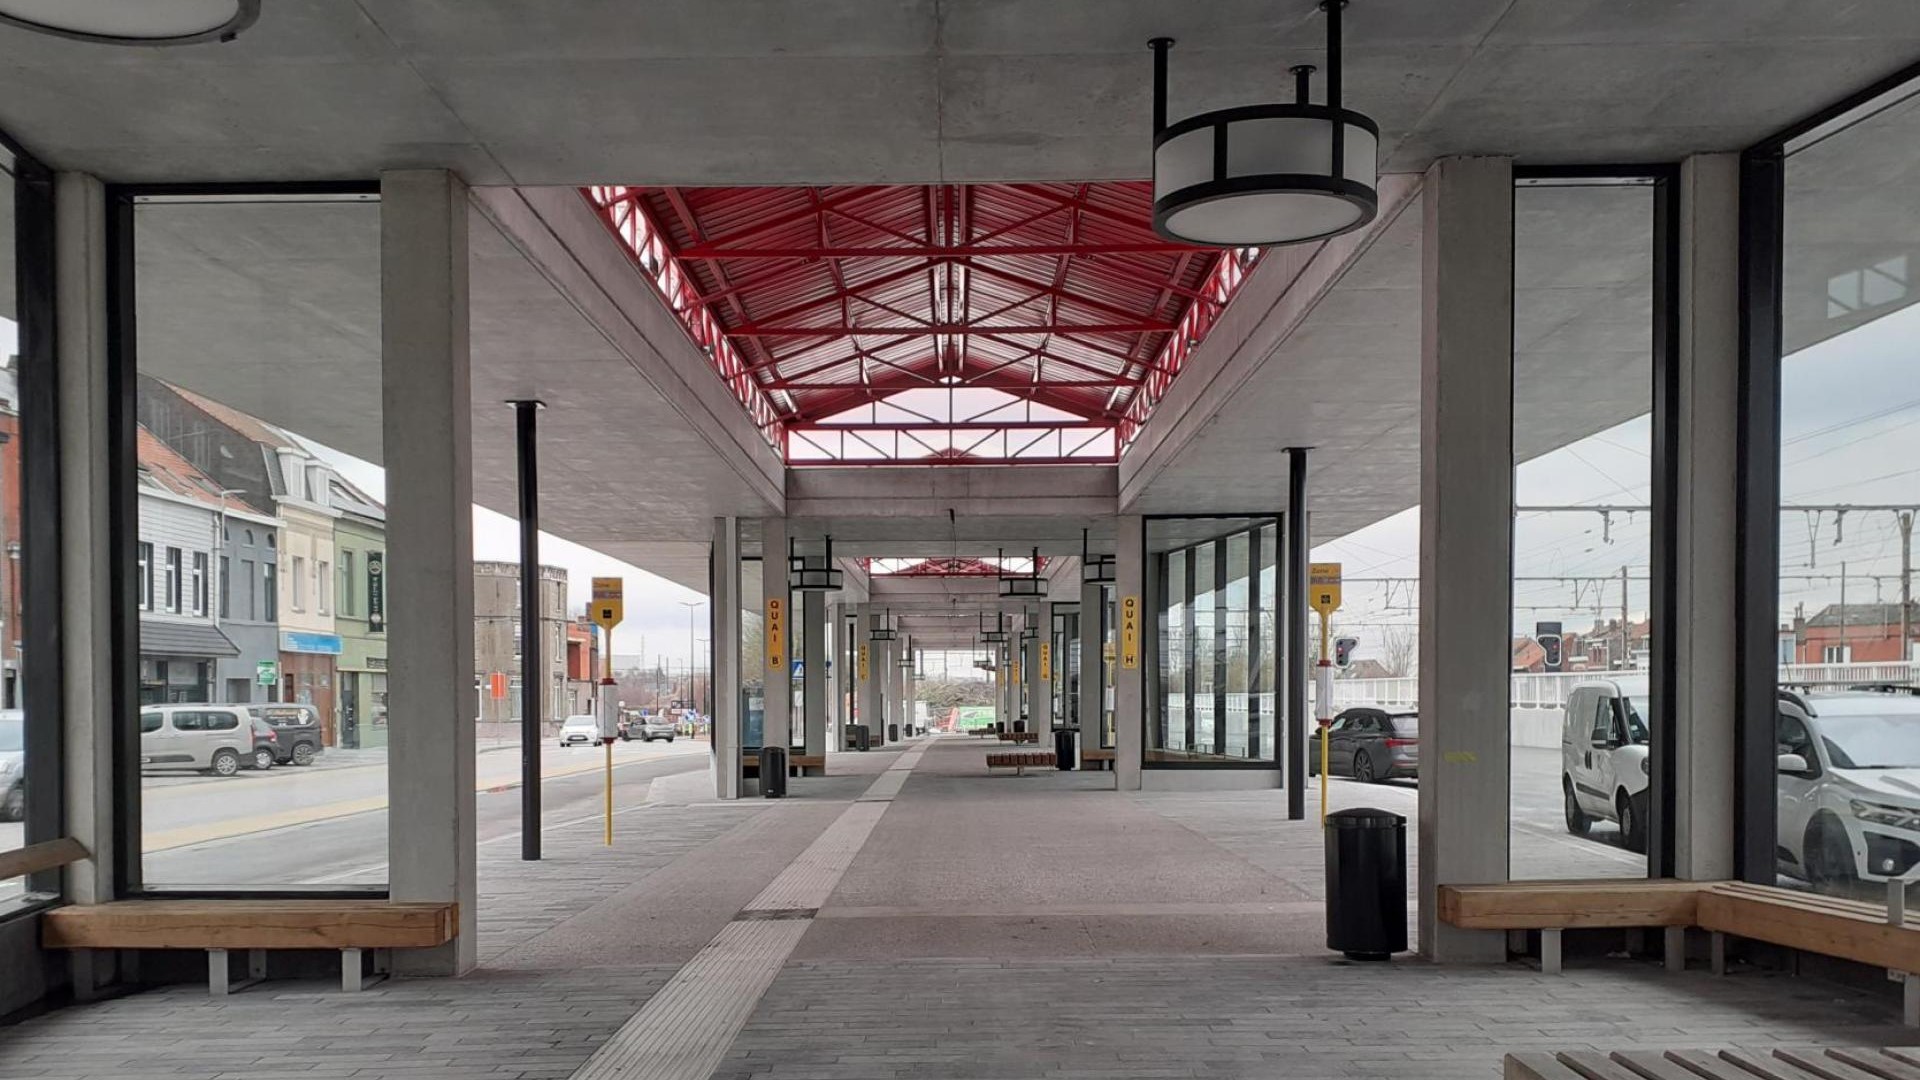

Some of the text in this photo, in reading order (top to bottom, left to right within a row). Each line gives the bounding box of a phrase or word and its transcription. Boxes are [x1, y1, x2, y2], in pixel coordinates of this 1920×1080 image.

[770, 600, 779, 664] QUAI B
[1125, 598, 1134, 663] QUAI H
